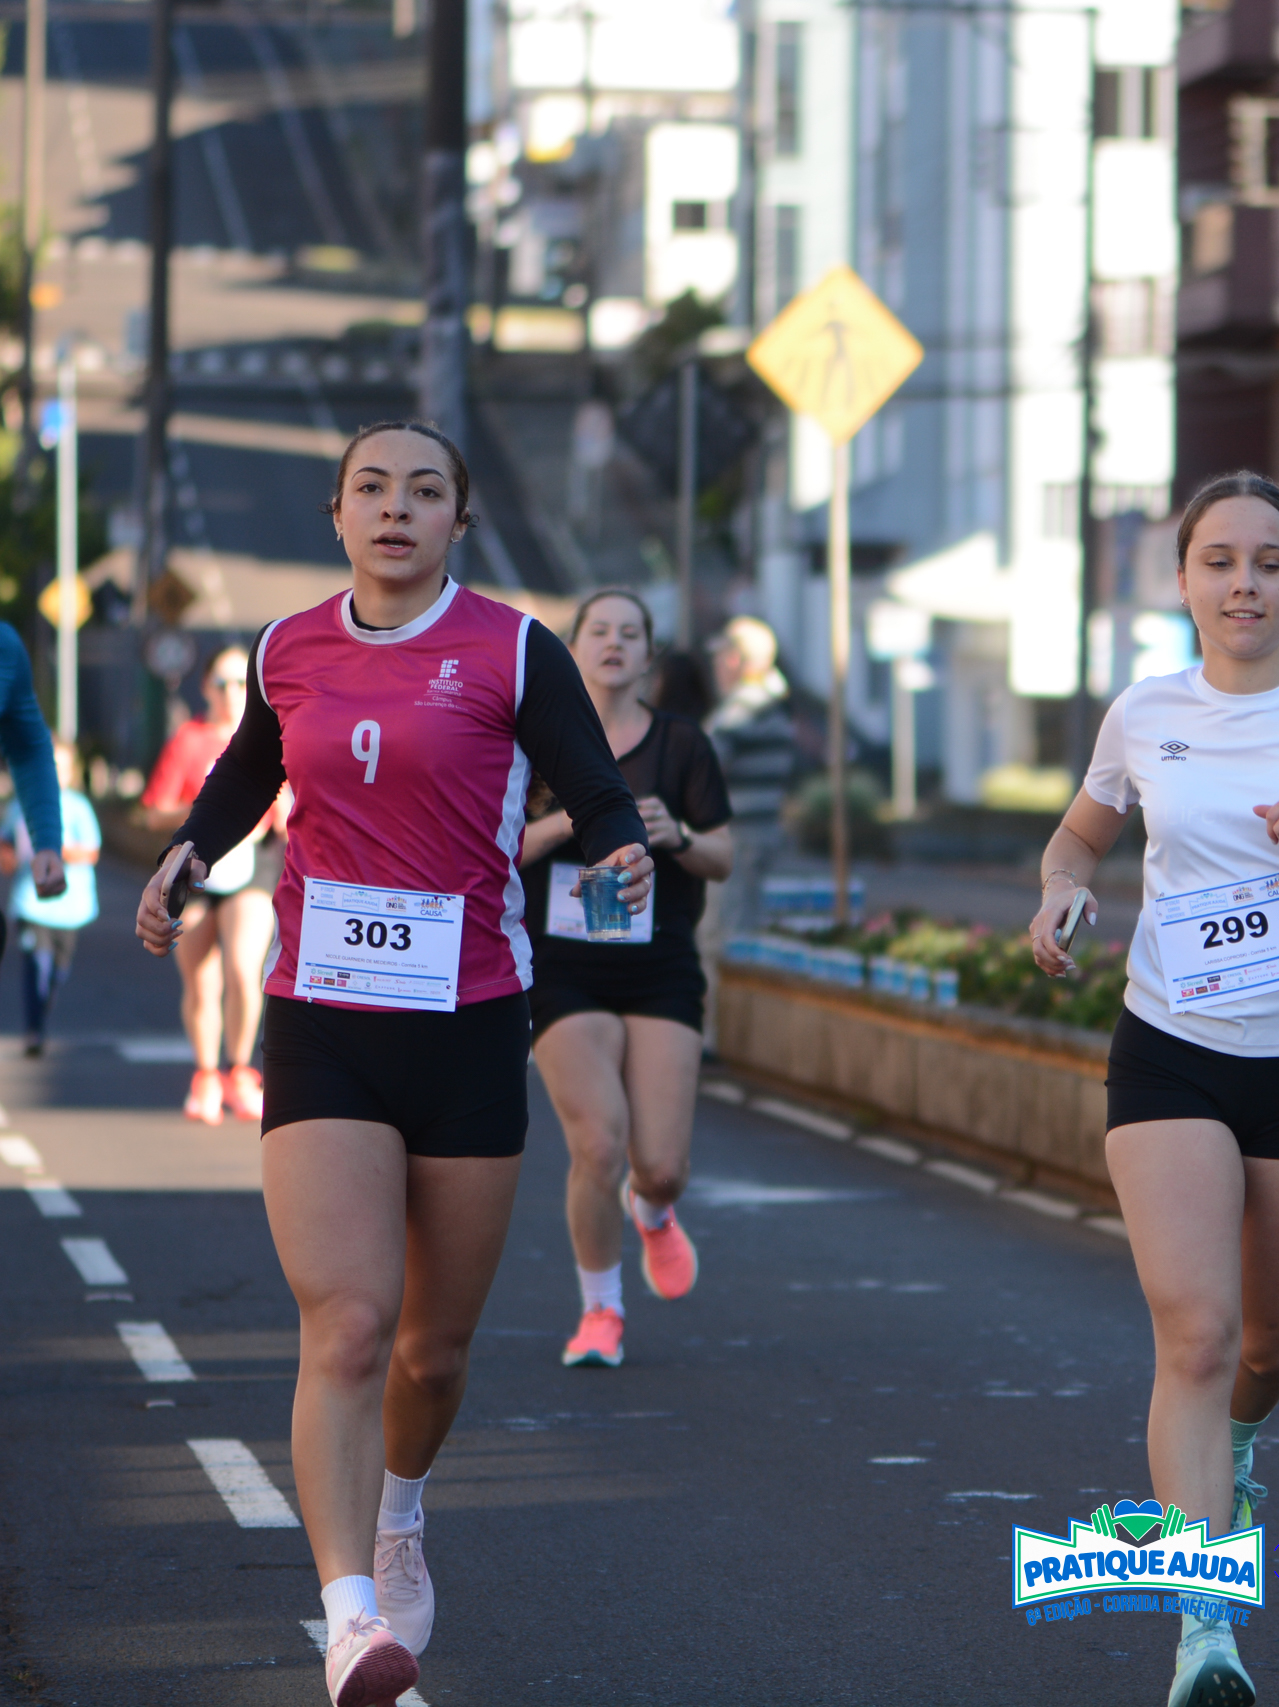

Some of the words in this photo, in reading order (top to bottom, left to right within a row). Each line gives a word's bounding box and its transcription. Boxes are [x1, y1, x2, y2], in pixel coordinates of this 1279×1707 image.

[429, 679, 463, 688] INSTITUTO
[351, 719, 381, 784] 9
[420, 909, 443, 917] CAUSA
[343, 918, 412, 951] 303
[1199, 911, 1269, 950] 299
